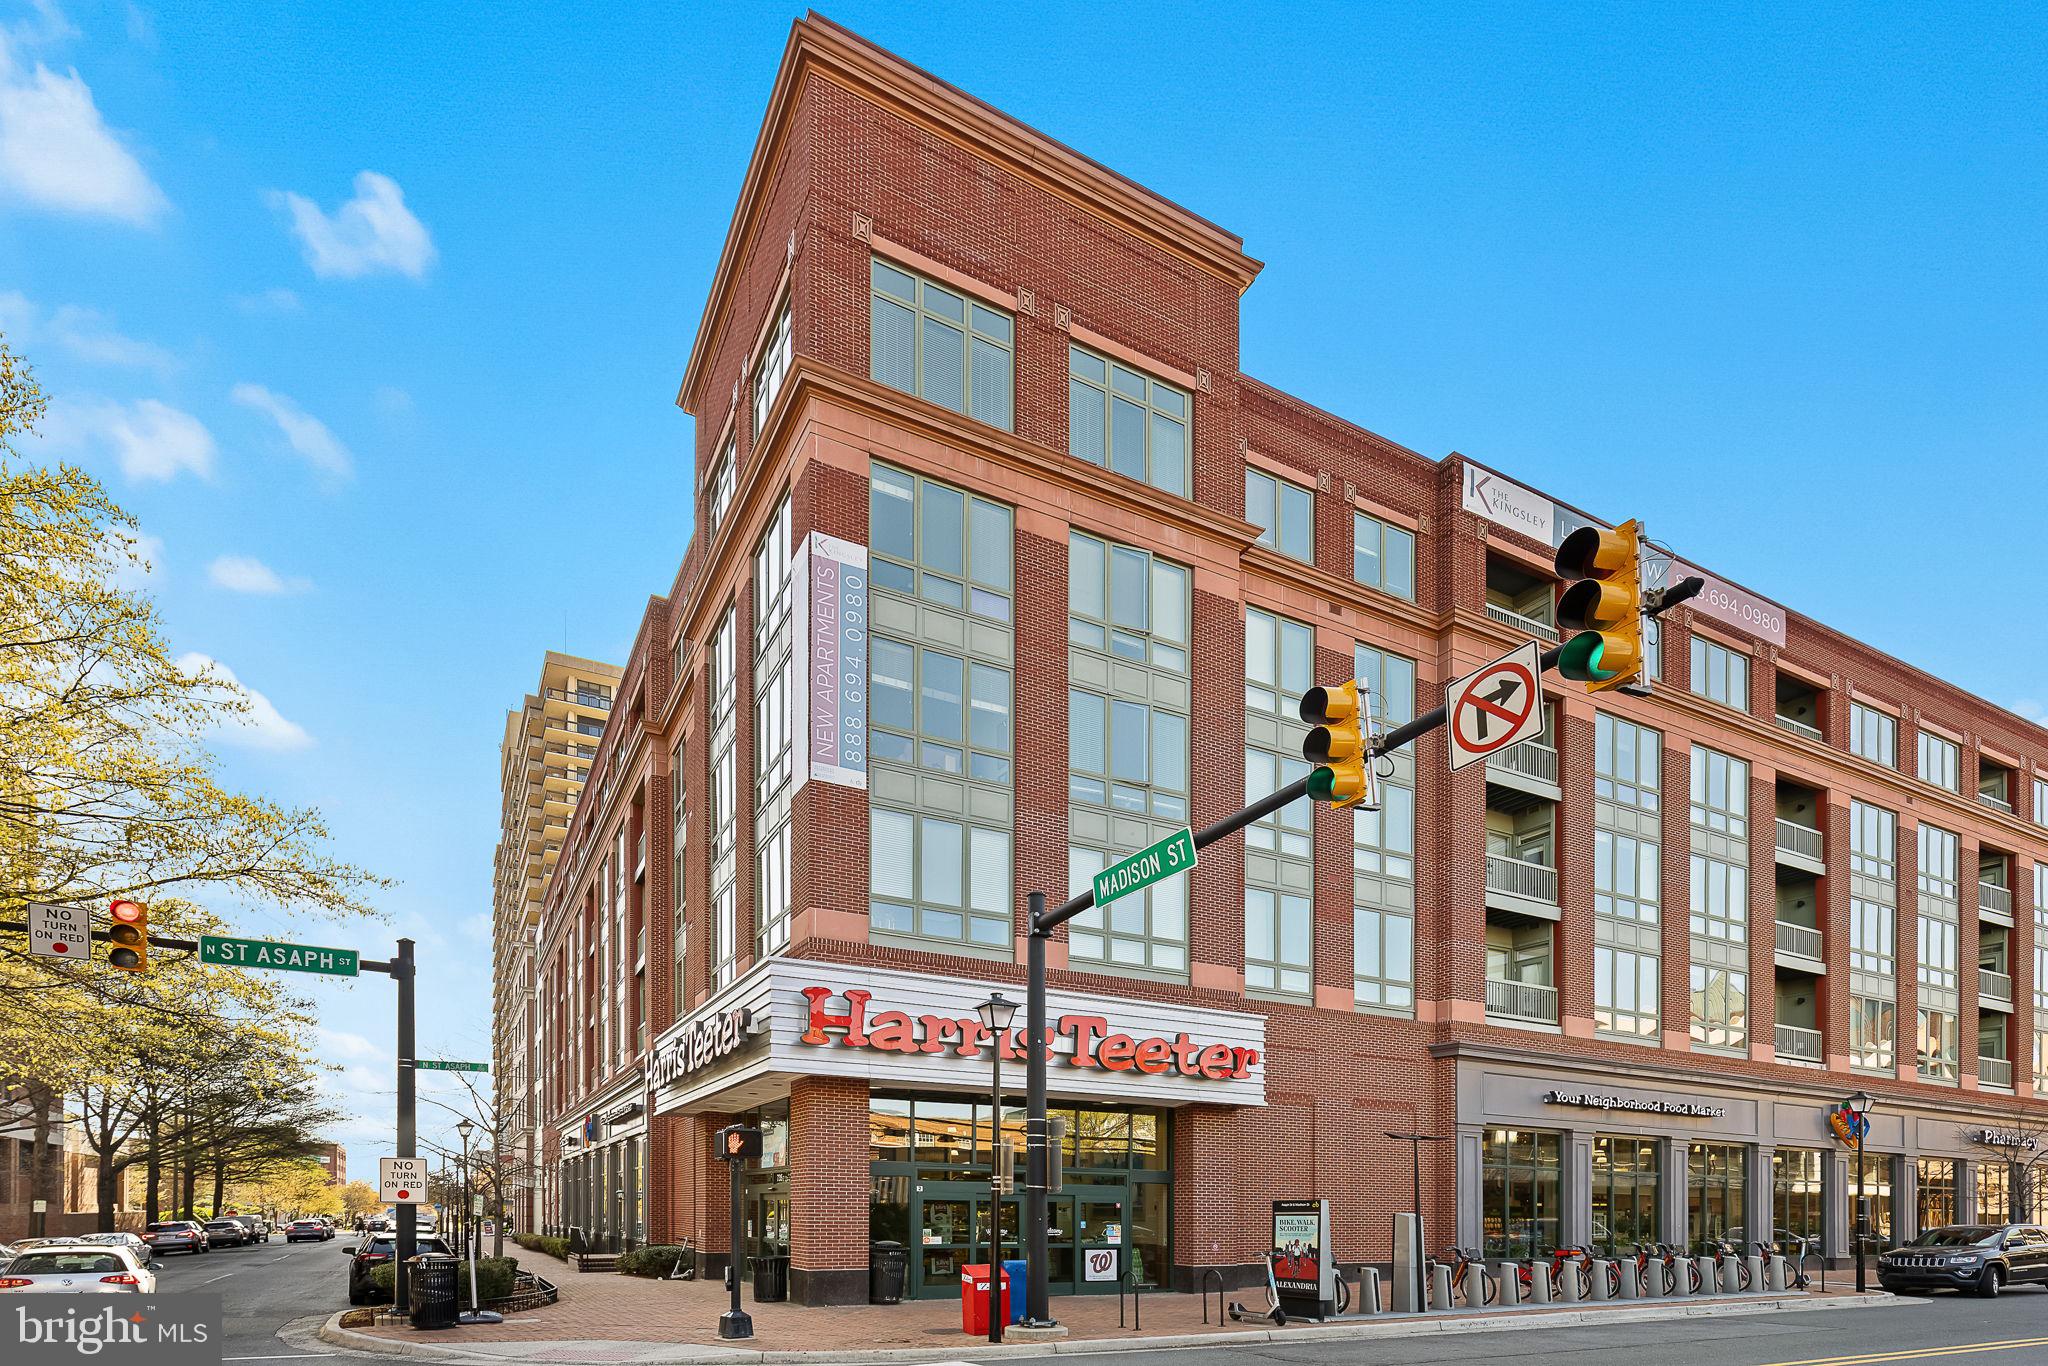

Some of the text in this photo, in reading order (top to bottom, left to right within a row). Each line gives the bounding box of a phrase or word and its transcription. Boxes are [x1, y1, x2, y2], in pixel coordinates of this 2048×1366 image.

[1491, 487, 1509, 501] THE
[1491, 498, 1546, 529] KINGSLEY
[816, 565, 835, 704] APARTMENTS
[844, 575, 863, 764] 888.694.0980
[816, 706, 835, 758] NEW
[1100, 838, 1186, 899] MADISON ST
[45, 907, 73, 921] NO
[34, 929, 85, 943] ON RED
[42, 919, 77, 932] TURN
[206, 942, 351, 969] N ST ASAPH ST
[644, 1007, 744, 1094] Harris Teeter
[1057, 1014, 1260, 1080] Teeter
[445, 1063, 471, 1071] ASAPH
[1554, 1091, 1726, 1118] Your Neighborhood Food Market
[1984, 1130, 2039, 1151] Pharmacy
[390, 1171, 417, 1180] TURN
[393, 1161, 414, 1171] NO
[384, 1181, 423, 1190] ON RED
[1276, 1280, 1318, 1291] ALEXANDRIA
